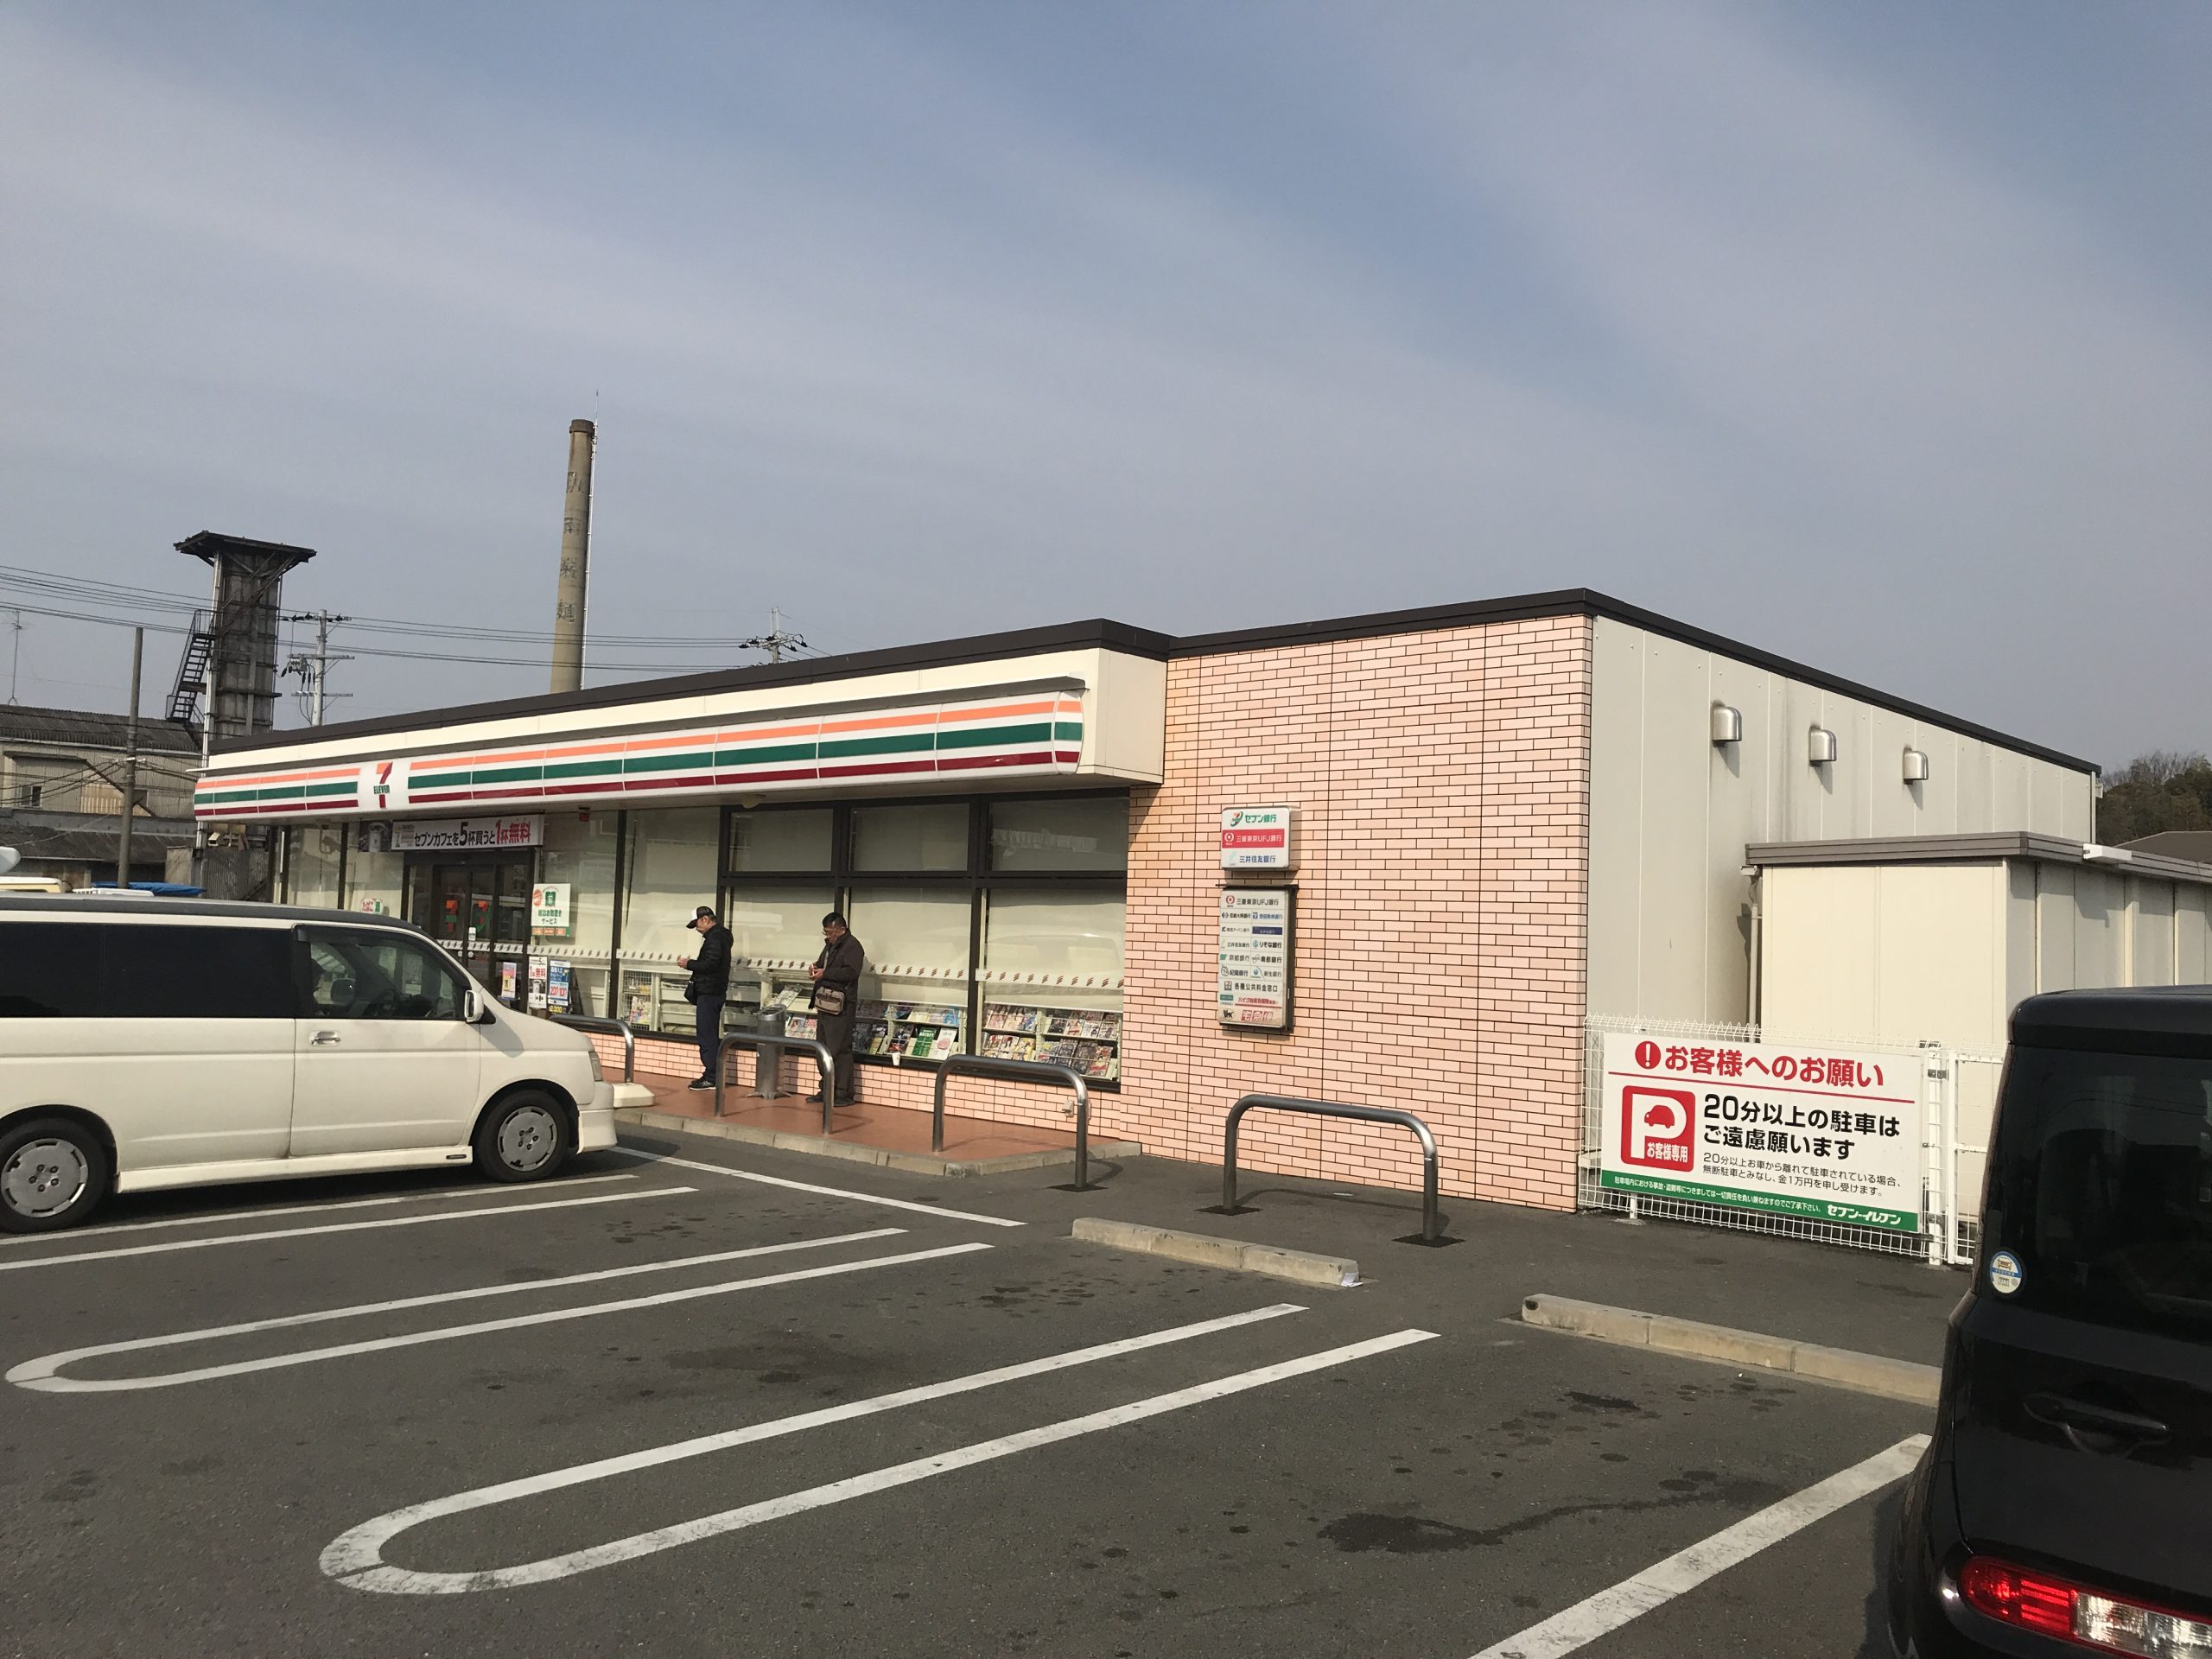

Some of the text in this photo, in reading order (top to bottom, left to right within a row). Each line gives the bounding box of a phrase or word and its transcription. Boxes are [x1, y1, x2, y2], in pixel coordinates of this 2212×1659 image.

[1245, 815, 1277, 823] セブン銀行
[1239, 855, 1276, 863] 三井住友銀行
[1664, 1046, 1884, 1088] お客様へのお願い
[1704, 1093, 1901, 1137] 20分以上の駐車は
[1646, 1141, 1688, 1163] お客様専用
[1703, 1124, 1855, 1160] ご遠慮願います
[1702, 1164, 1883, 1197] 無断駐車とみなし、金1万円を申し受けます。
[1703, 1152, 1901, 1187] 20分以上お車から離れて駐車されている場合、
